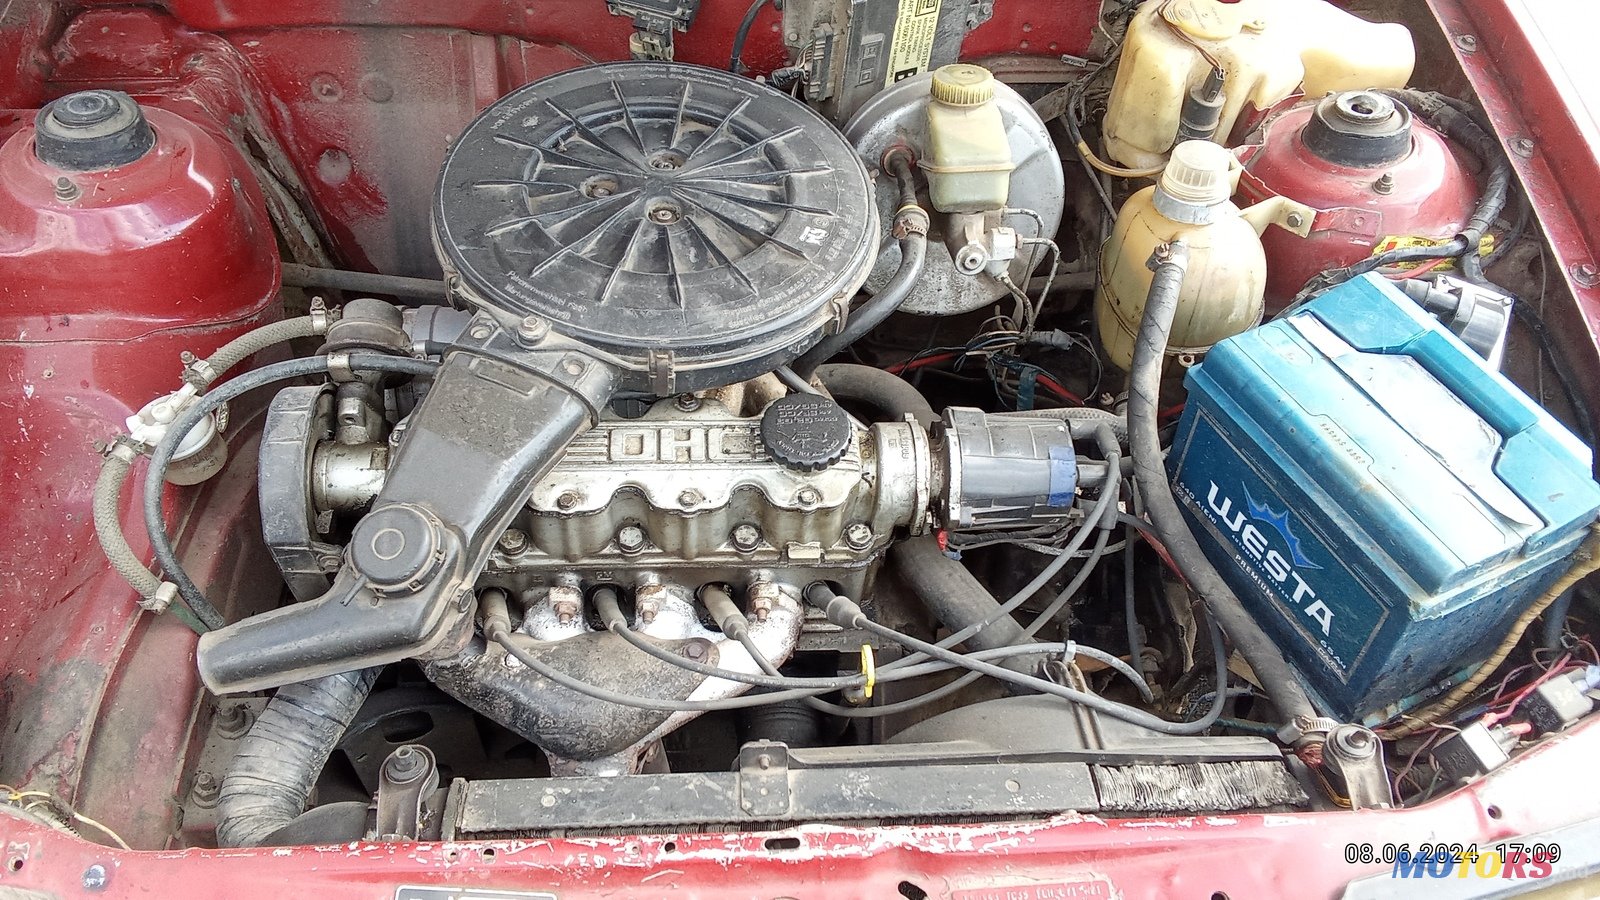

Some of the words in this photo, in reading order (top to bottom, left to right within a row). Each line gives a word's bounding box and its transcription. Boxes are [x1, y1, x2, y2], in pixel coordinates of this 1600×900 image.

[908, 20, 916, 44] CONTROL
[926, 25, 934, 41] VOLT
[921, 42, 930, 67] SYSTEM
[610, 428, 755, 463] OHC
[1179, 482, 1195, 500] 640
[1207, 479, 1336, 637] WESTA
[1231, 534, 1265, 572] AUTOMOTIVE
[1267, 574, 1294, 603] BATTERY
[1235, 554, 1275, 599] PREMIUM
